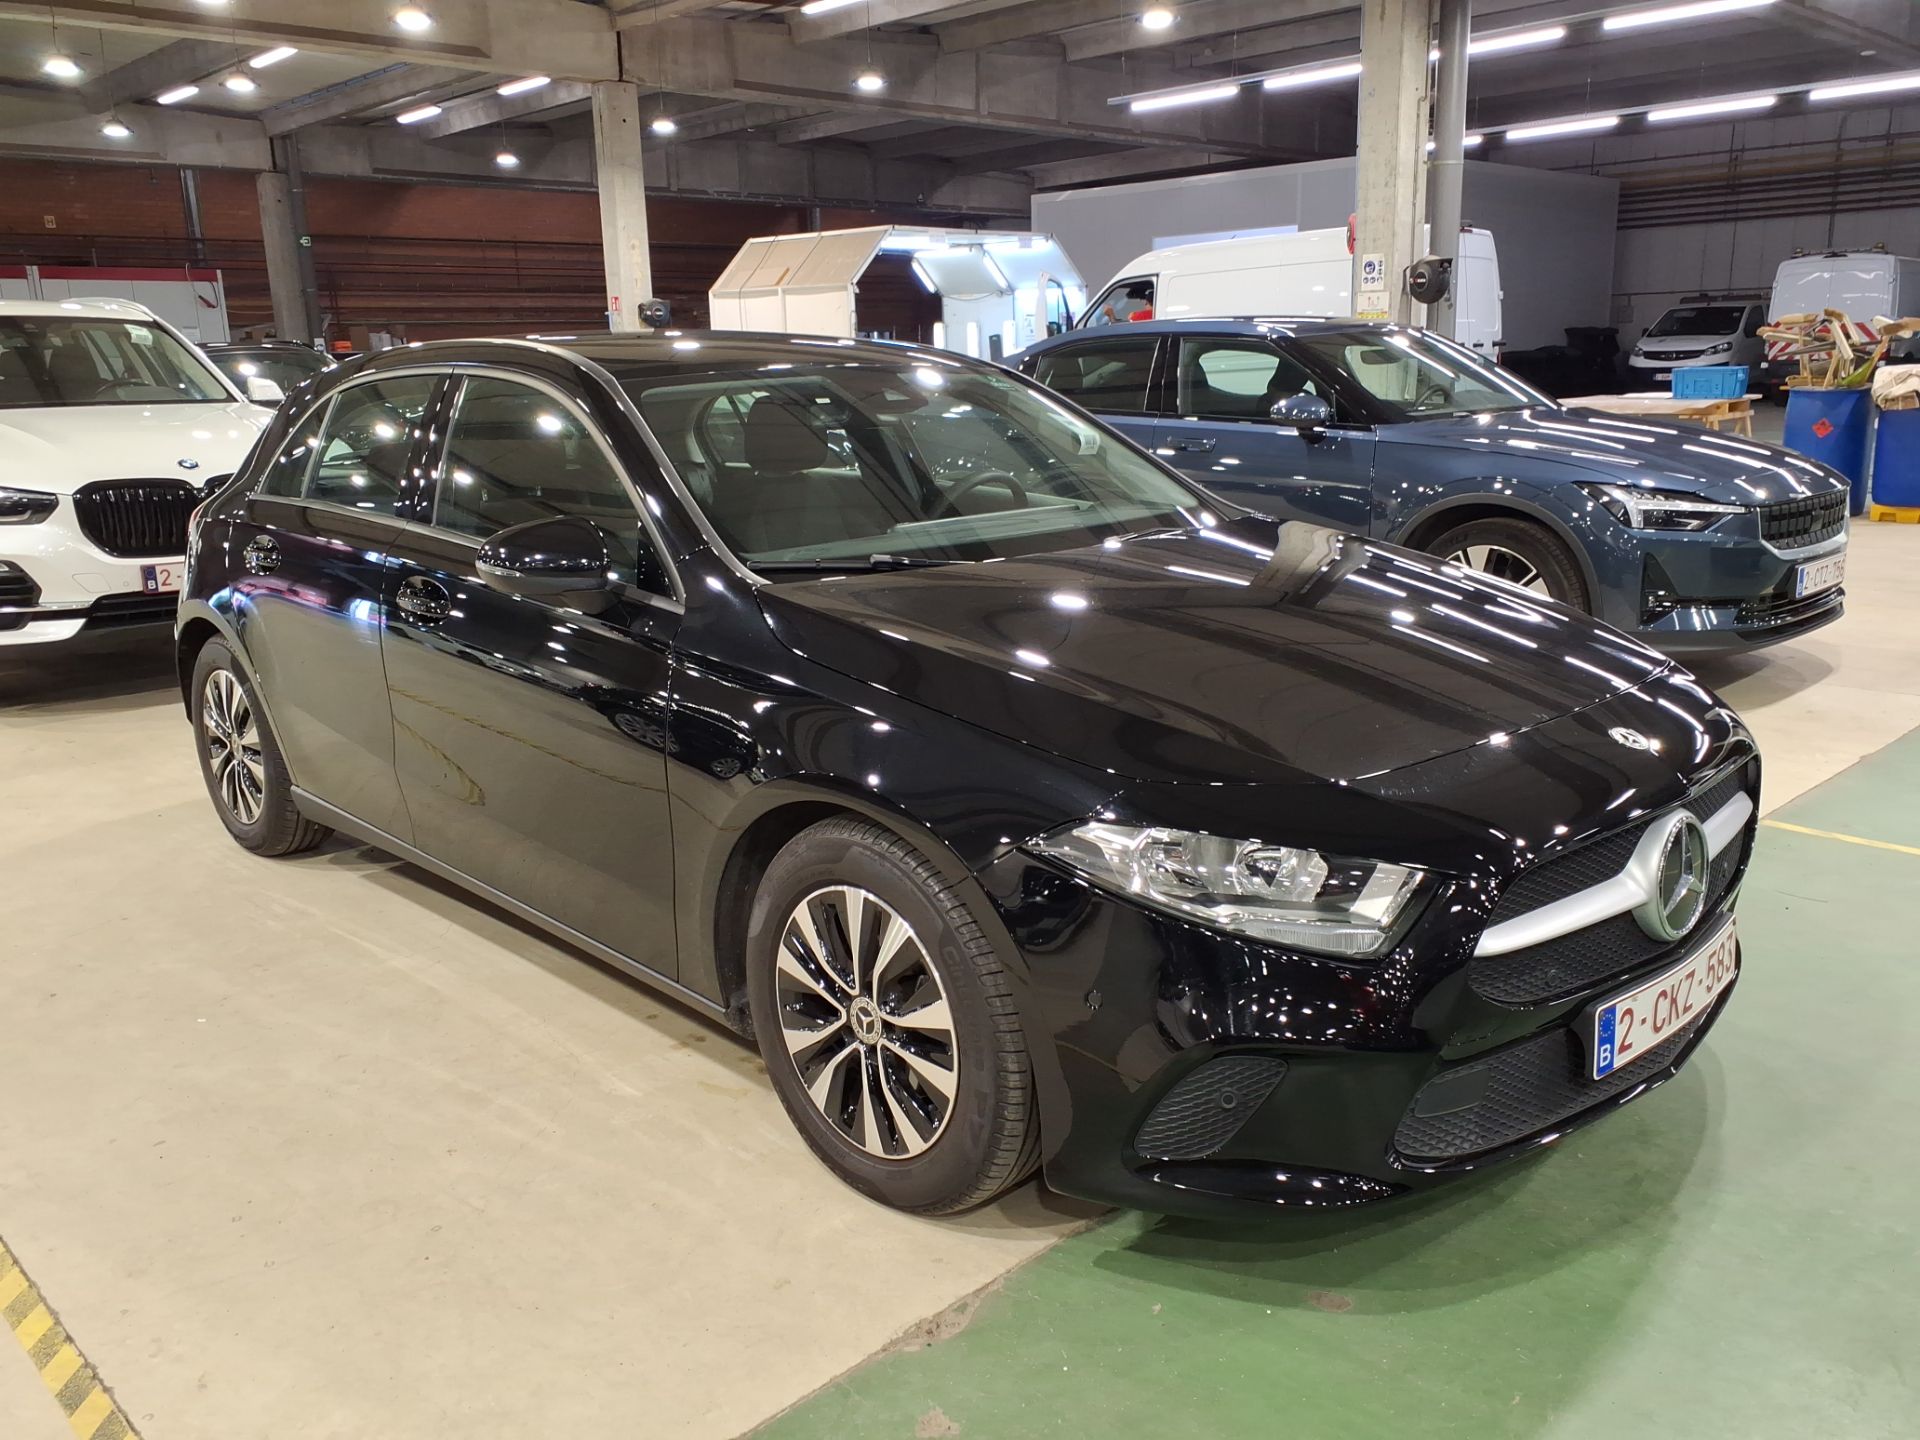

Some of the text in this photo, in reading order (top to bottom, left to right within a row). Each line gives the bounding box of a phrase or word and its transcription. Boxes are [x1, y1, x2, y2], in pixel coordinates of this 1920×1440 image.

[147, 580, 156, 589] B
[1617, 931, 1735, 1056] 2-CKZ-583
[1600, 1044, 1611, 1068] B
